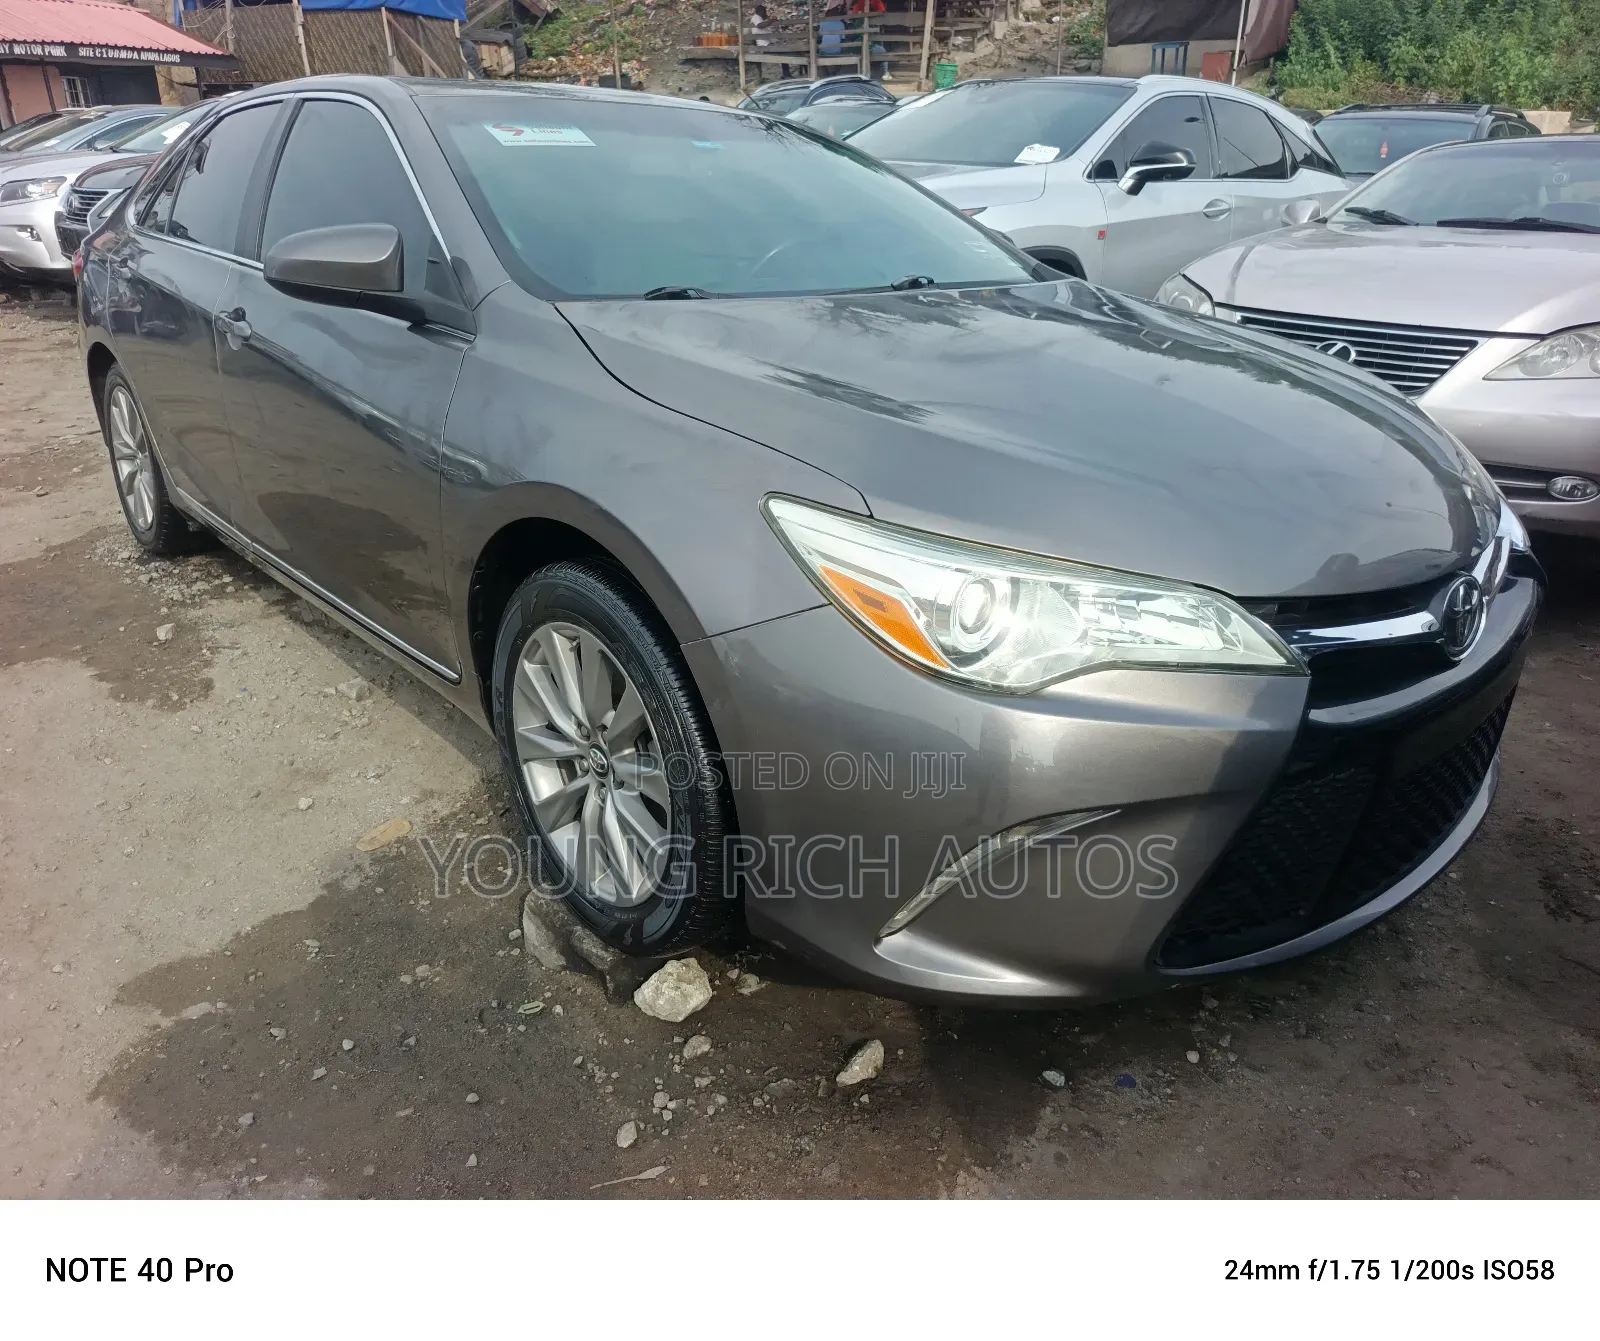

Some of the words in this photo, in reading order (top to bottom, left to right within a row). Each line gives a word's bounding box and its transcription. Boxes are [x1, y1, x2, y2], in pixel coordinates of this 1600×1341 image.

[13, 43, 44, 56] MOTOR
[44, 44, 67, 57] PARK
[78, 47, 95, 58] SITE
[160, 52, 181, 63] LAGOS
